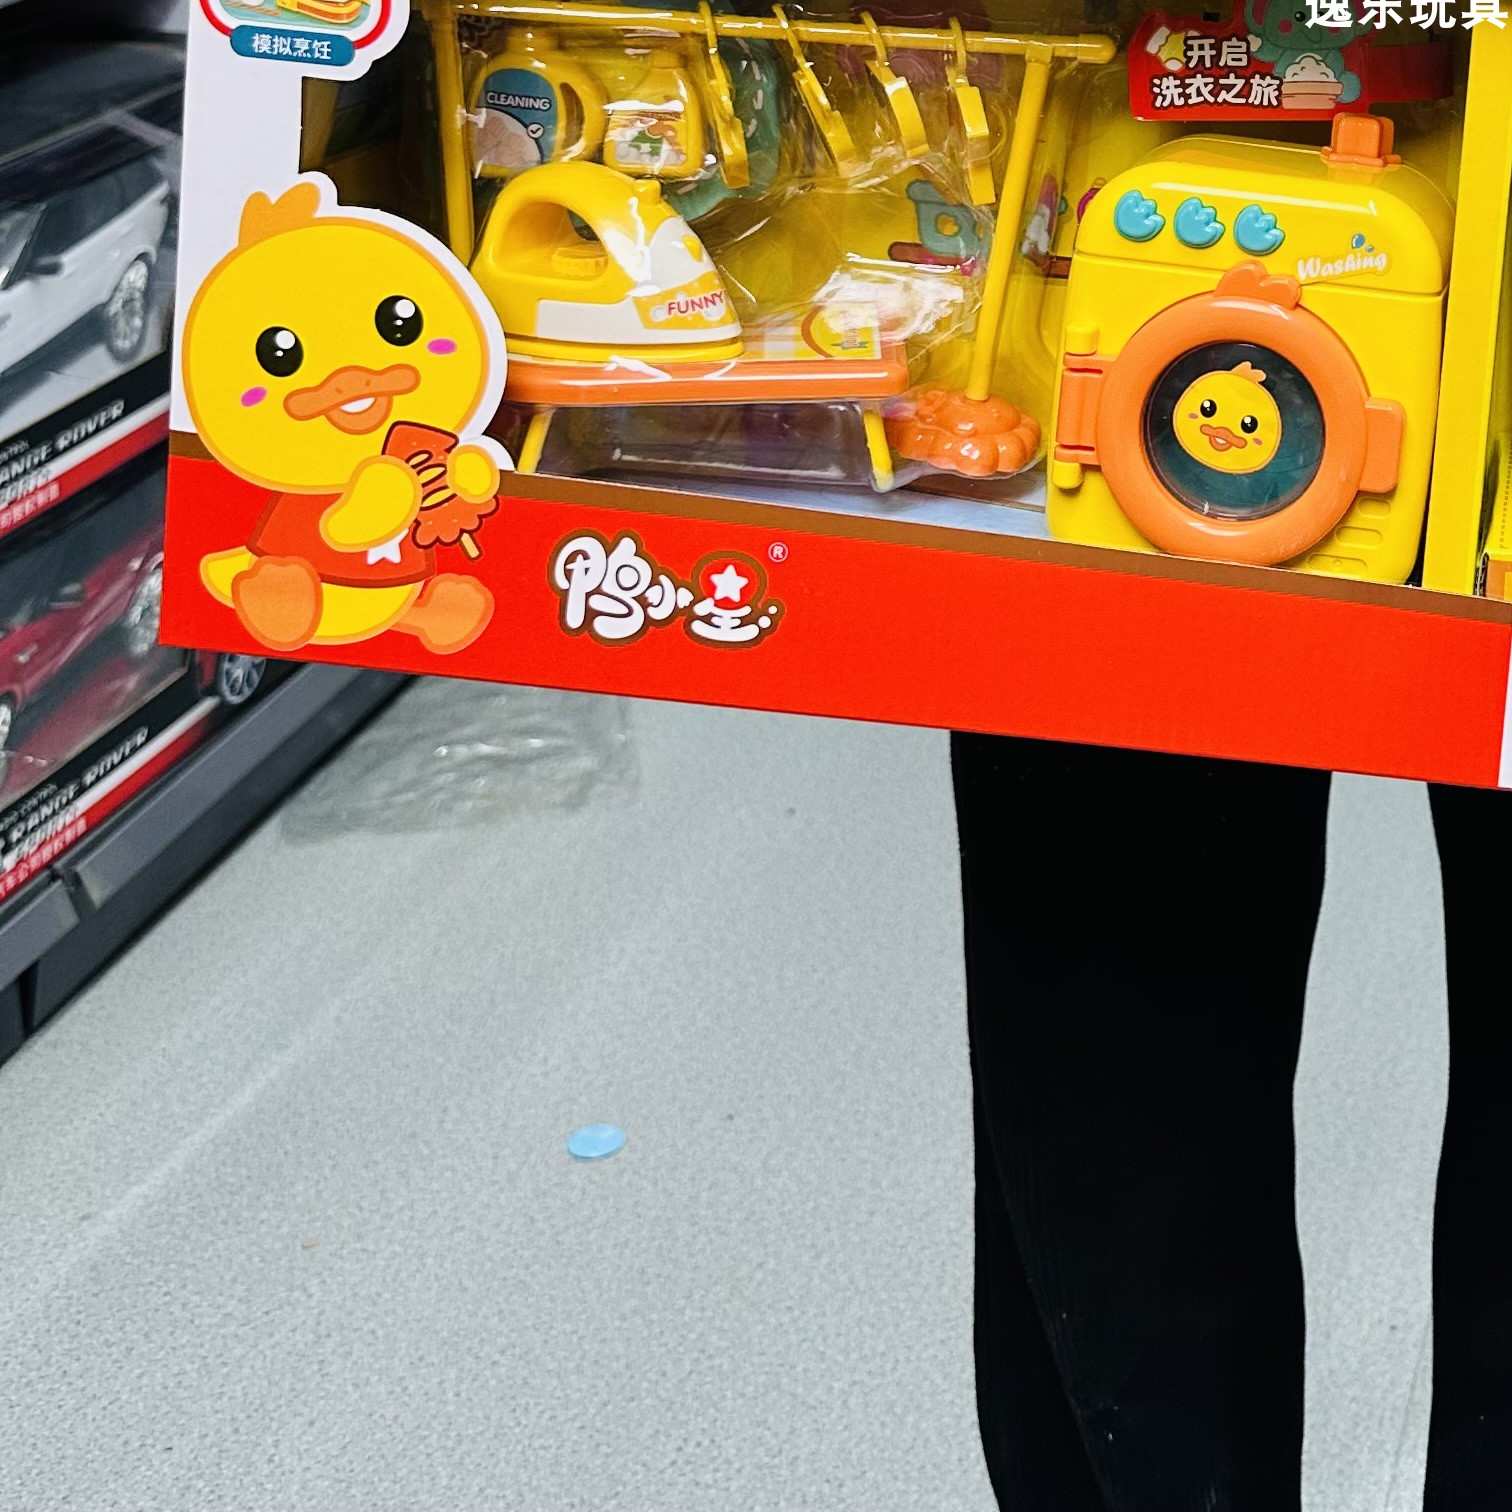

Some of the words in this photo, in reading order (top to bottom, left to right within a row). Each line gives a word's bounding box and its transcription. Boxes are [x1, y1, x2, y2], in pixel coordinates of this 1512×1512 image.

[252, 33, 333, 61] 模拟烹饪
[1185, 37, 1248, 69] 开启
[486, 91, 551, 112] CLEANING
[1152, 74, 1282, 108] 洗衣之旅
[1297, 249, 1388, 281] Washing
[667, 292, 726, 316] FUNNY
